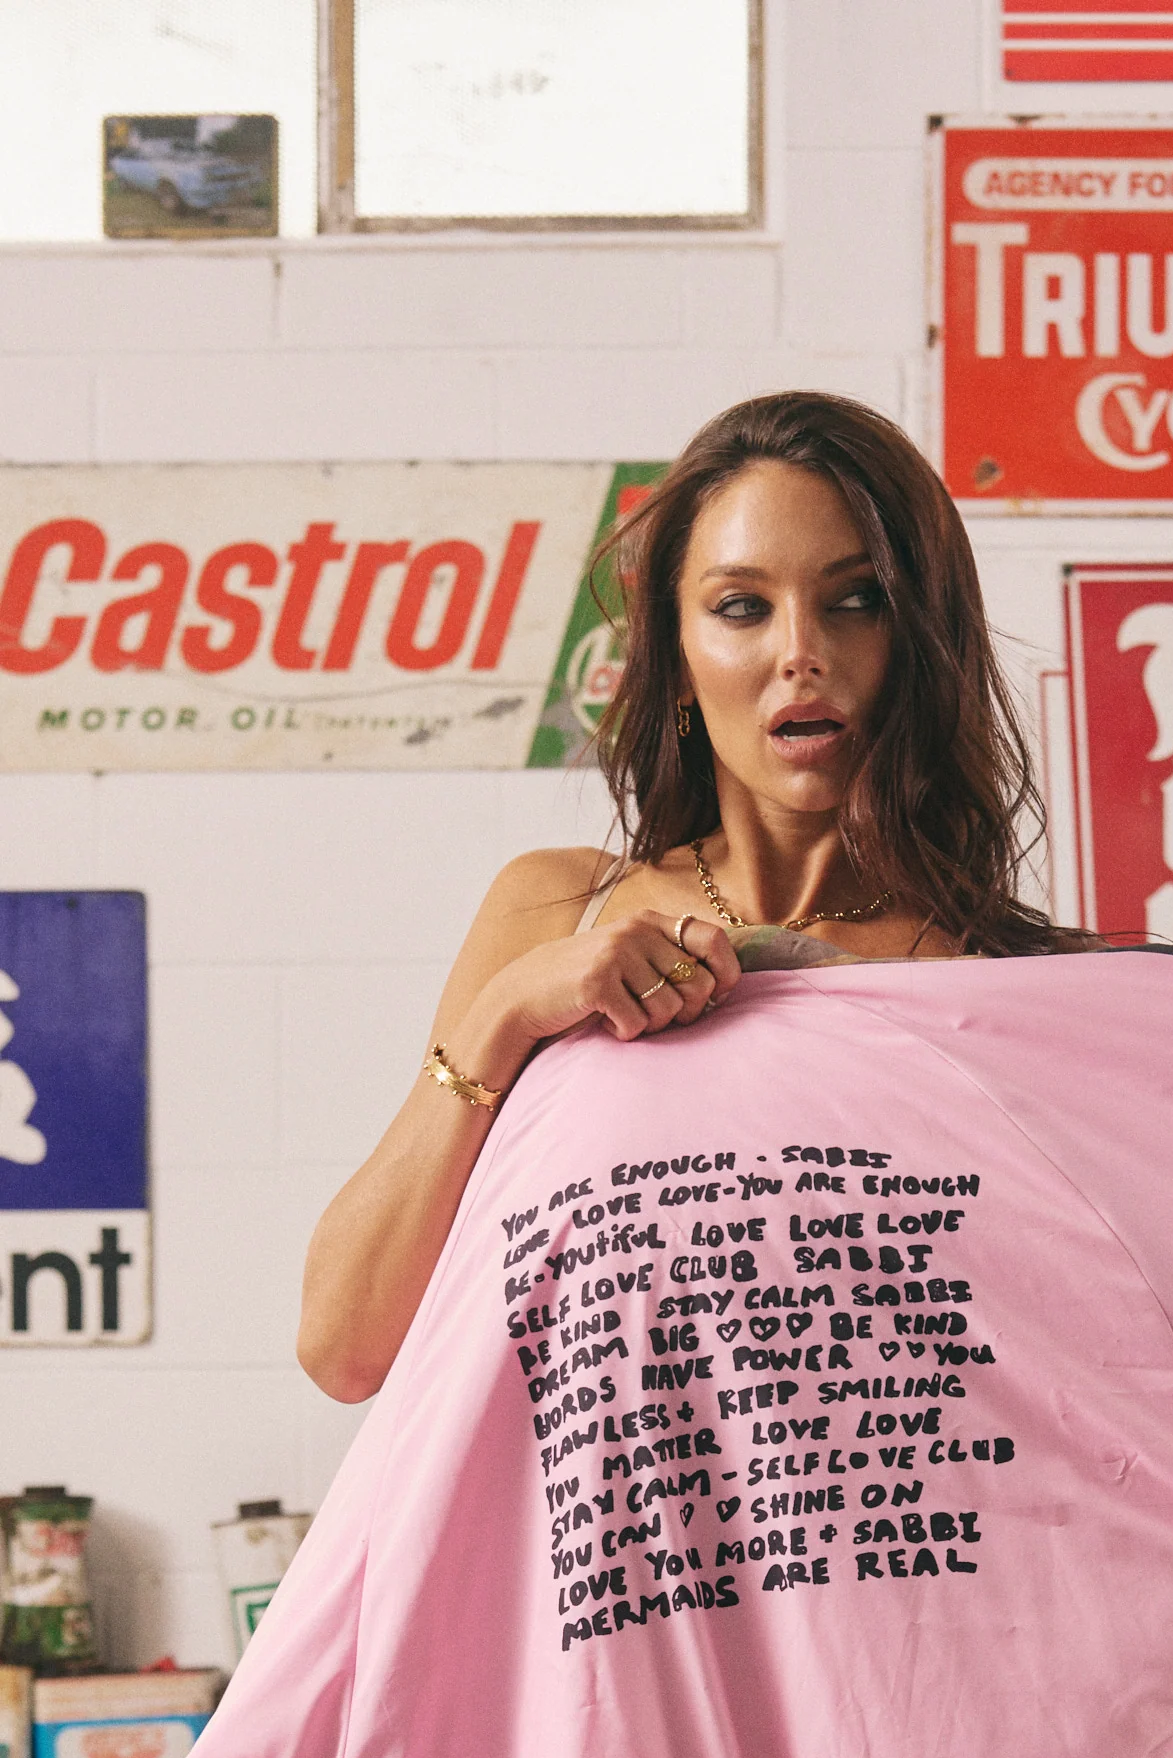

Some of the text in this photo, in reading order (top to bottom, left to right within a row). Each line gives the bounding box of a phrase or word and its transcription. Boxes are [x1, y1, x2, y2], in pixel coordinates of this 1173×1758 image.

[983, 171, 1112, 198] AGENCY
[0, 517, 543, 676] Castrol
[38, 707, 198, 732] MOTOR
[230, 707, 302, 732] OIL
[500, 1205, 539, 1242] YOU
[548, 1177, 594, 1212] ARE
[610, 1151, 736, 1187] ENOUGH
[780, 1144, 893, 1169] SABBI
[571, 1192, 642, 1229] LOVE
[794, 1171, 847, 1195] ARE
[862, 1173, 981, 1198] ENOUGH
[690, 1217, 767, 1249] LOVE
[789, 1212, 865, 1242] LOVE
[876, 1209, 966, 1236] LOVE
[0, 1227, 132, 1332] nt
[507, 1243, 934, 1339] SELF LOVE CLUB SABBI
[516, 1277, 973, 1376] BE KIND STAY CALM SABBI
[527, 1311, 968, 1403] DREAM BIG BE KIND
[641, 1354, 715, 1391] HAVE
[731, 1343, 854, 1373] POWER
[717, 1380, 800, 1420] KEEP
[817, 1372, 967, 1405] SMILING
[545, 1406, 943, 1515] YOU MATTER LOVE LOVE
[551, 1488, 615, 1551] STAY
[625, 1468, 712, 1515] CALM
[927, 1436, 1016, 1465] CLUB
[550, 1479, 924, 1580] YOU CAN SHINE ON
[558, 1565, 628, 1616] LOVE
[714, 1526, 808, 1568] MORE
[852, 1511, 982, 1545] SABBI
[561, 1547, 978, 1652] MERMAIDS ARE REAL
